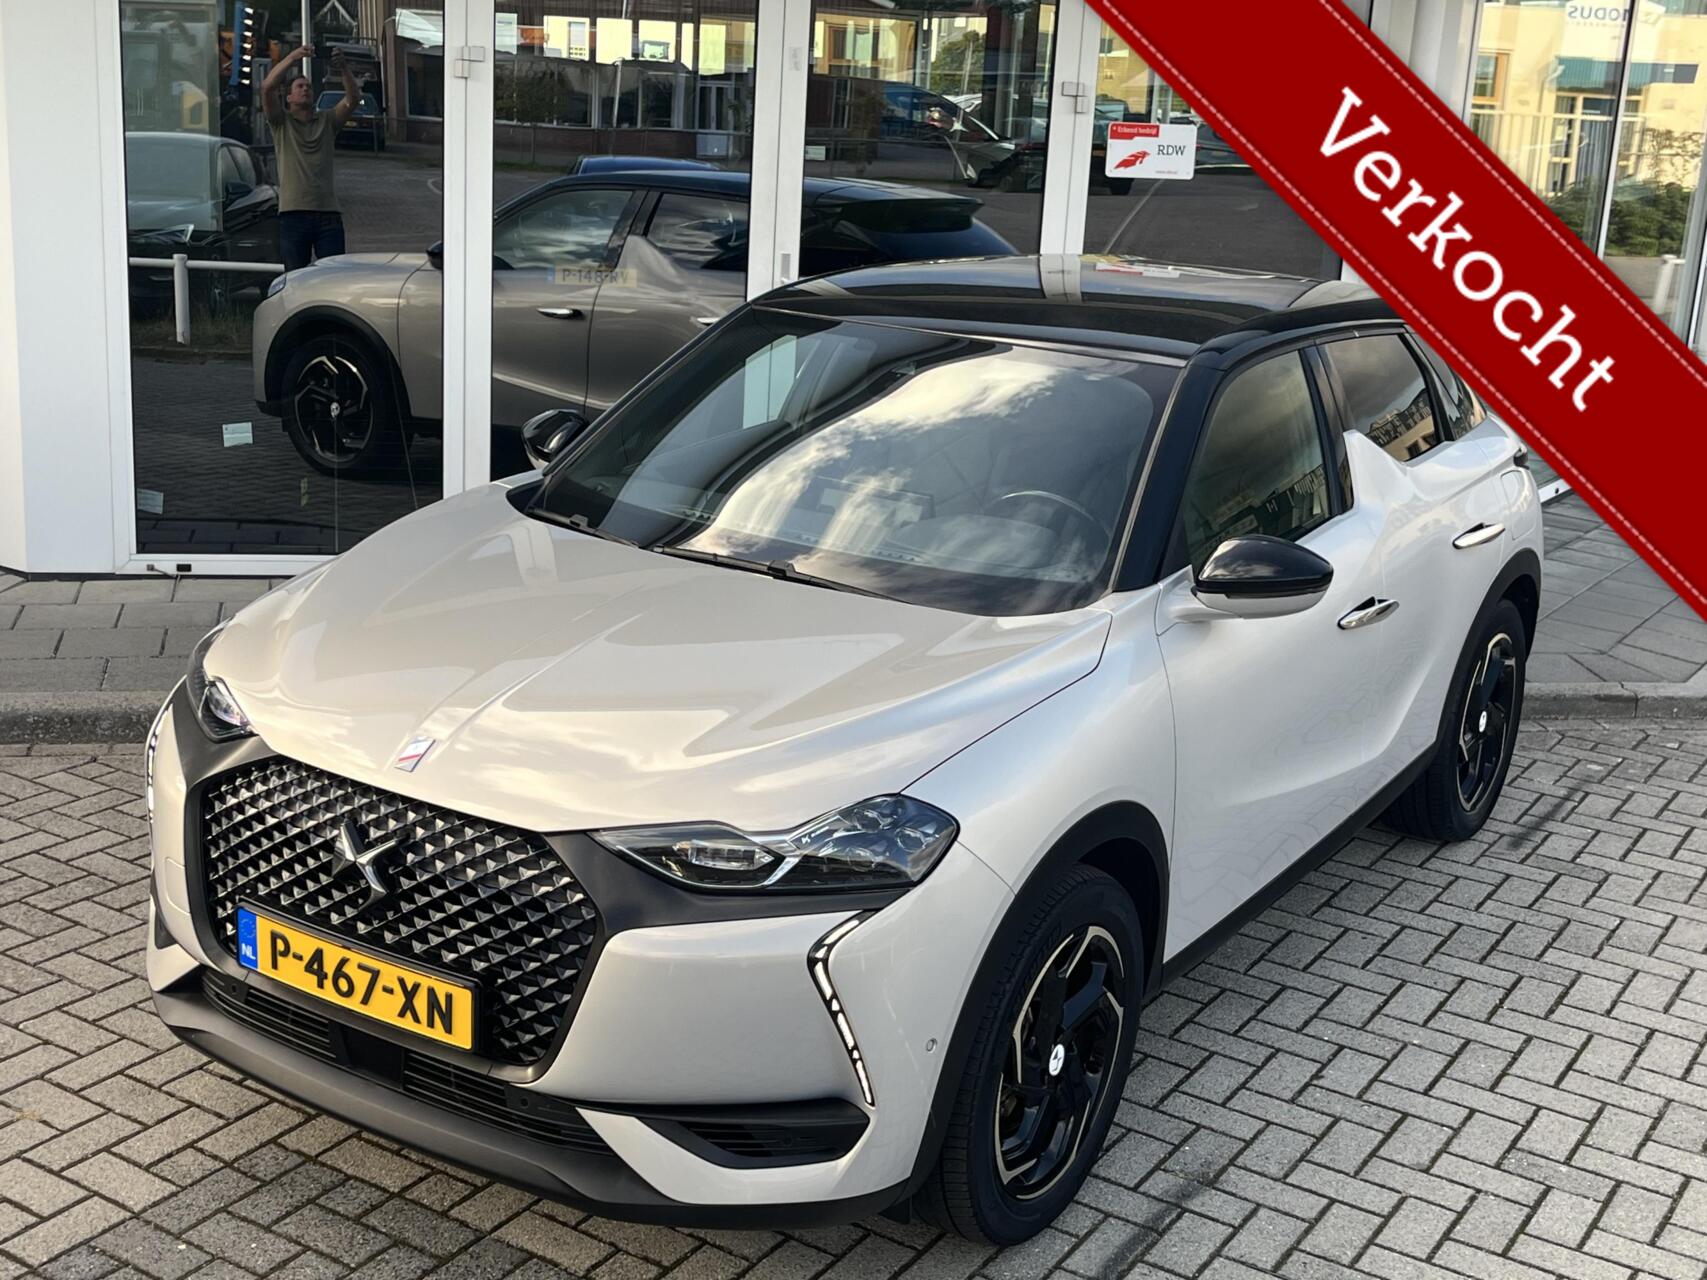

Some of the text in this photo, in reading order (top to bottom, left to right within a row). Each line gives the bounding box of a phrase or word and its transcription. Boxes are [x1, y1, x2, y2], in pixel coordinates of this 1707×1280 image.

[1157, 144, 1186, 156] RDW
[241, 942, 257, 961] NL
[269, 928, 454, 1036] P-467-XN
